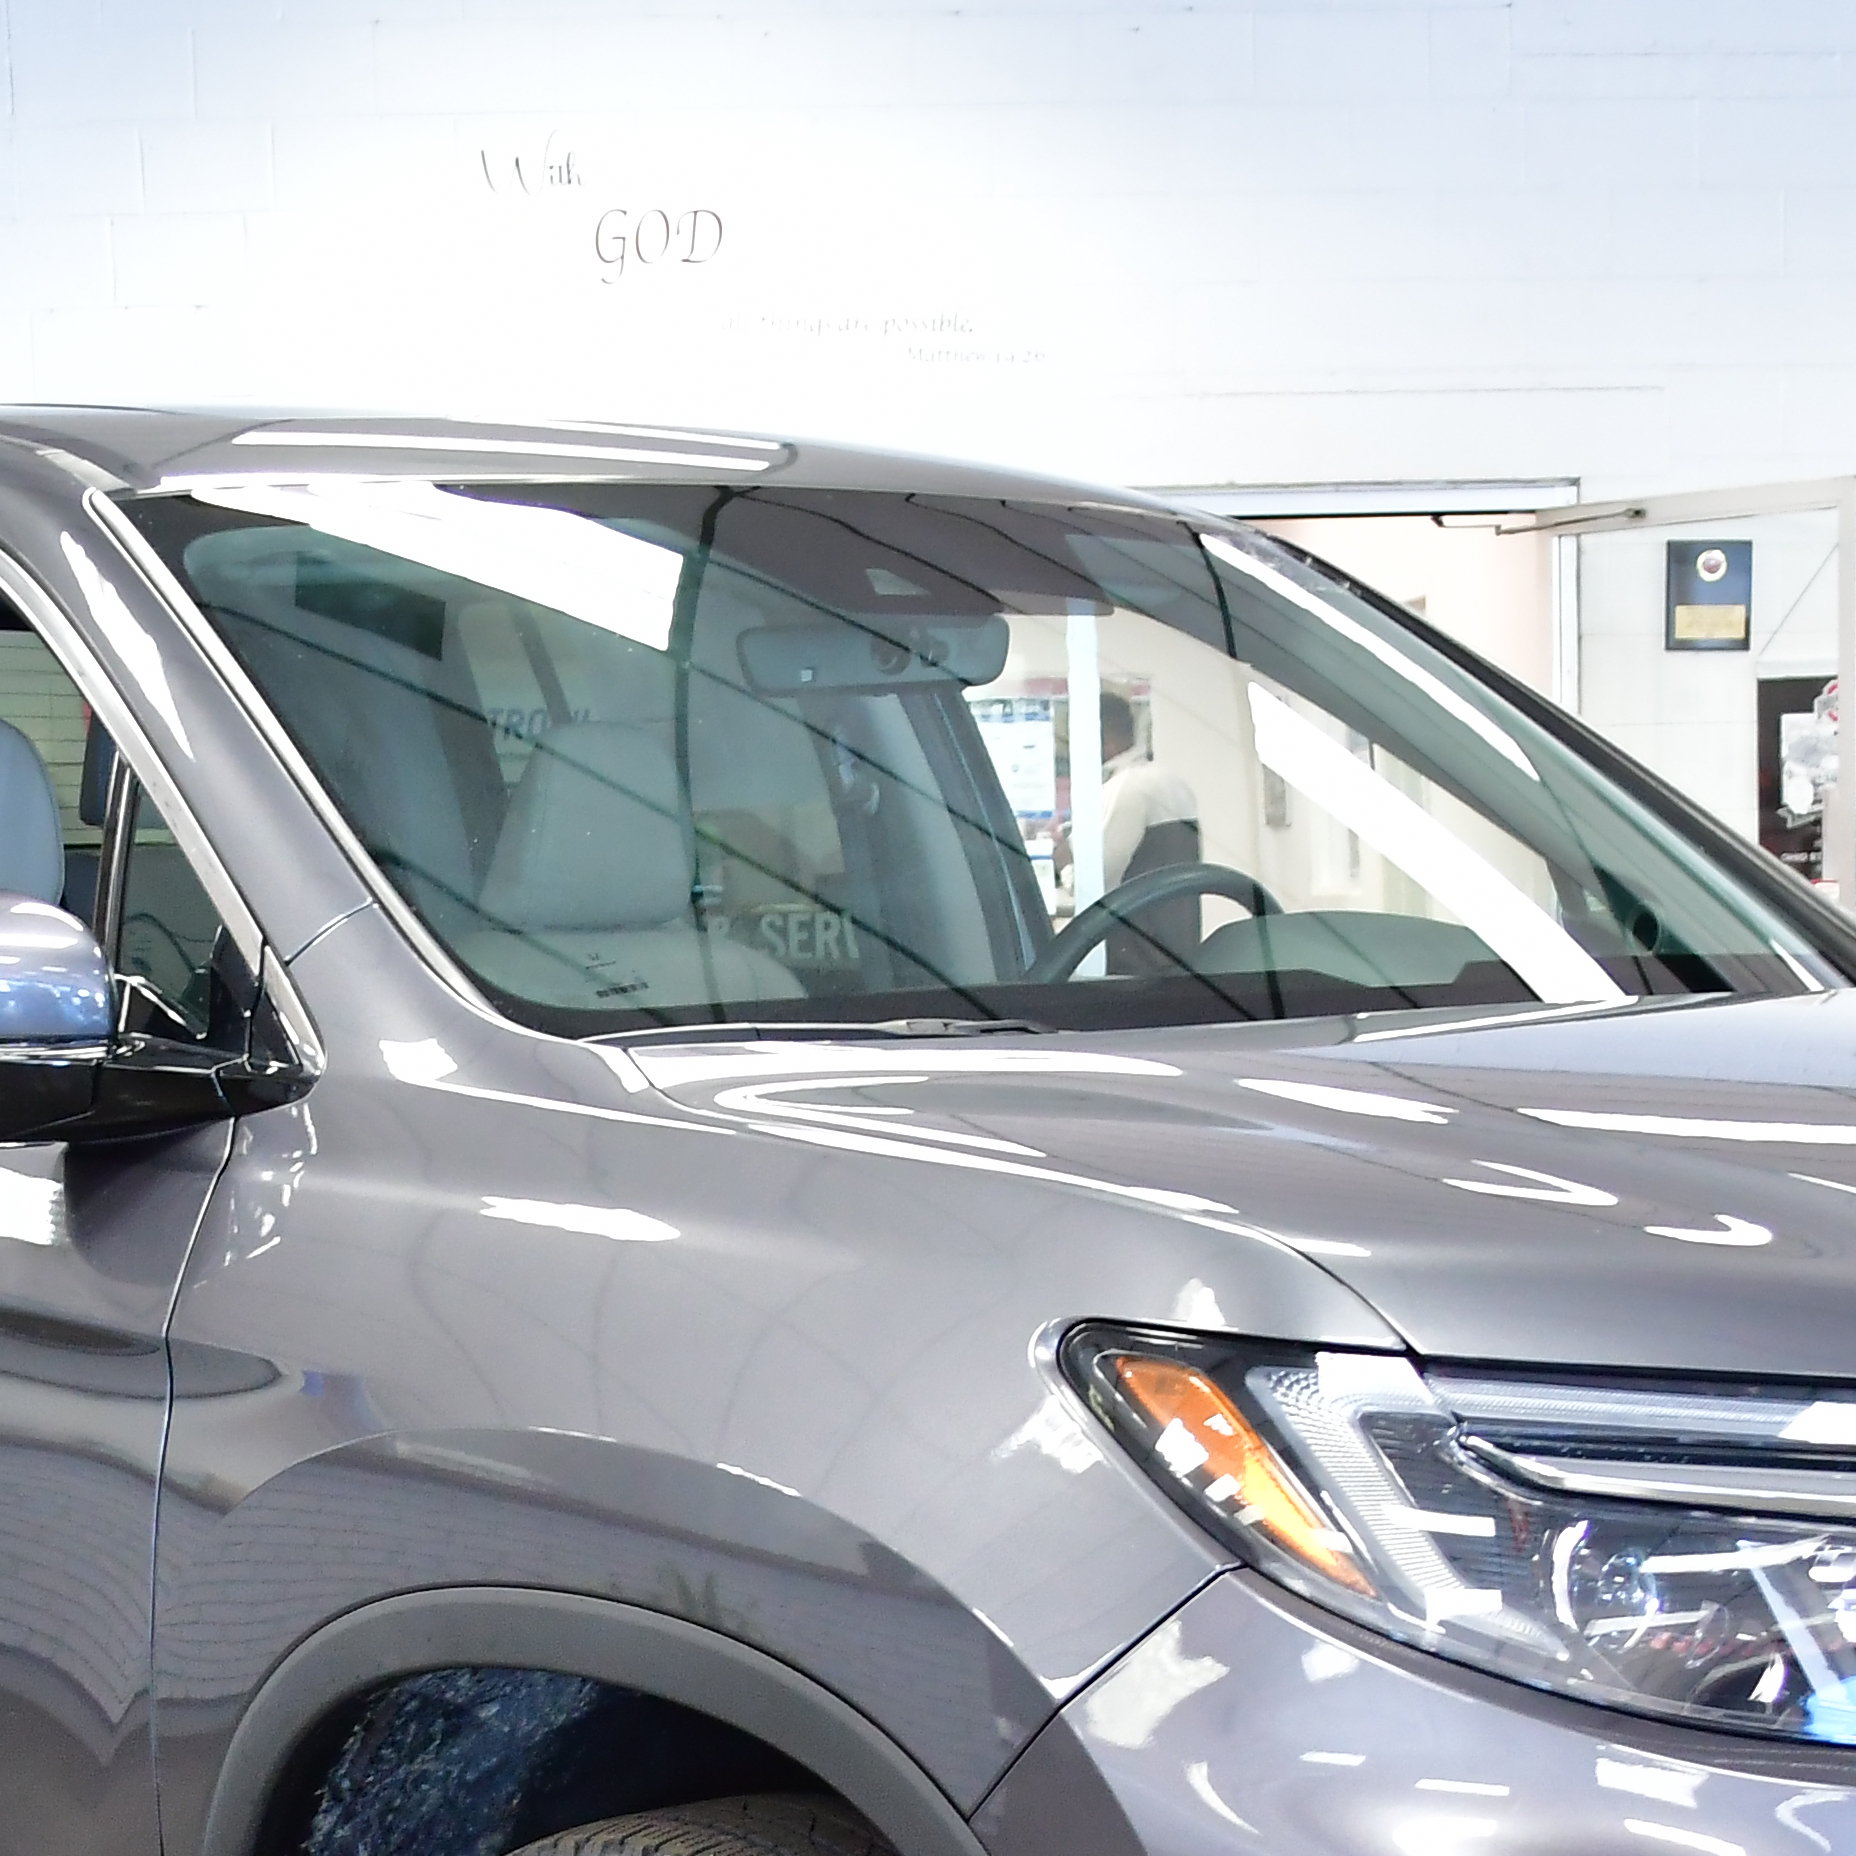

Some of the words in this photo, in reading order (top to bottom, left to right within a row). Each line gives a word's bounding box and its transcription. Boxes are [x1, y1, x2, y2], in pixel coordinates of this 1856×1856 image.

[480, 129, 584, 195] With
[594, 207, 724, 286] GOD
[882, 311, 976, 336] possible.
